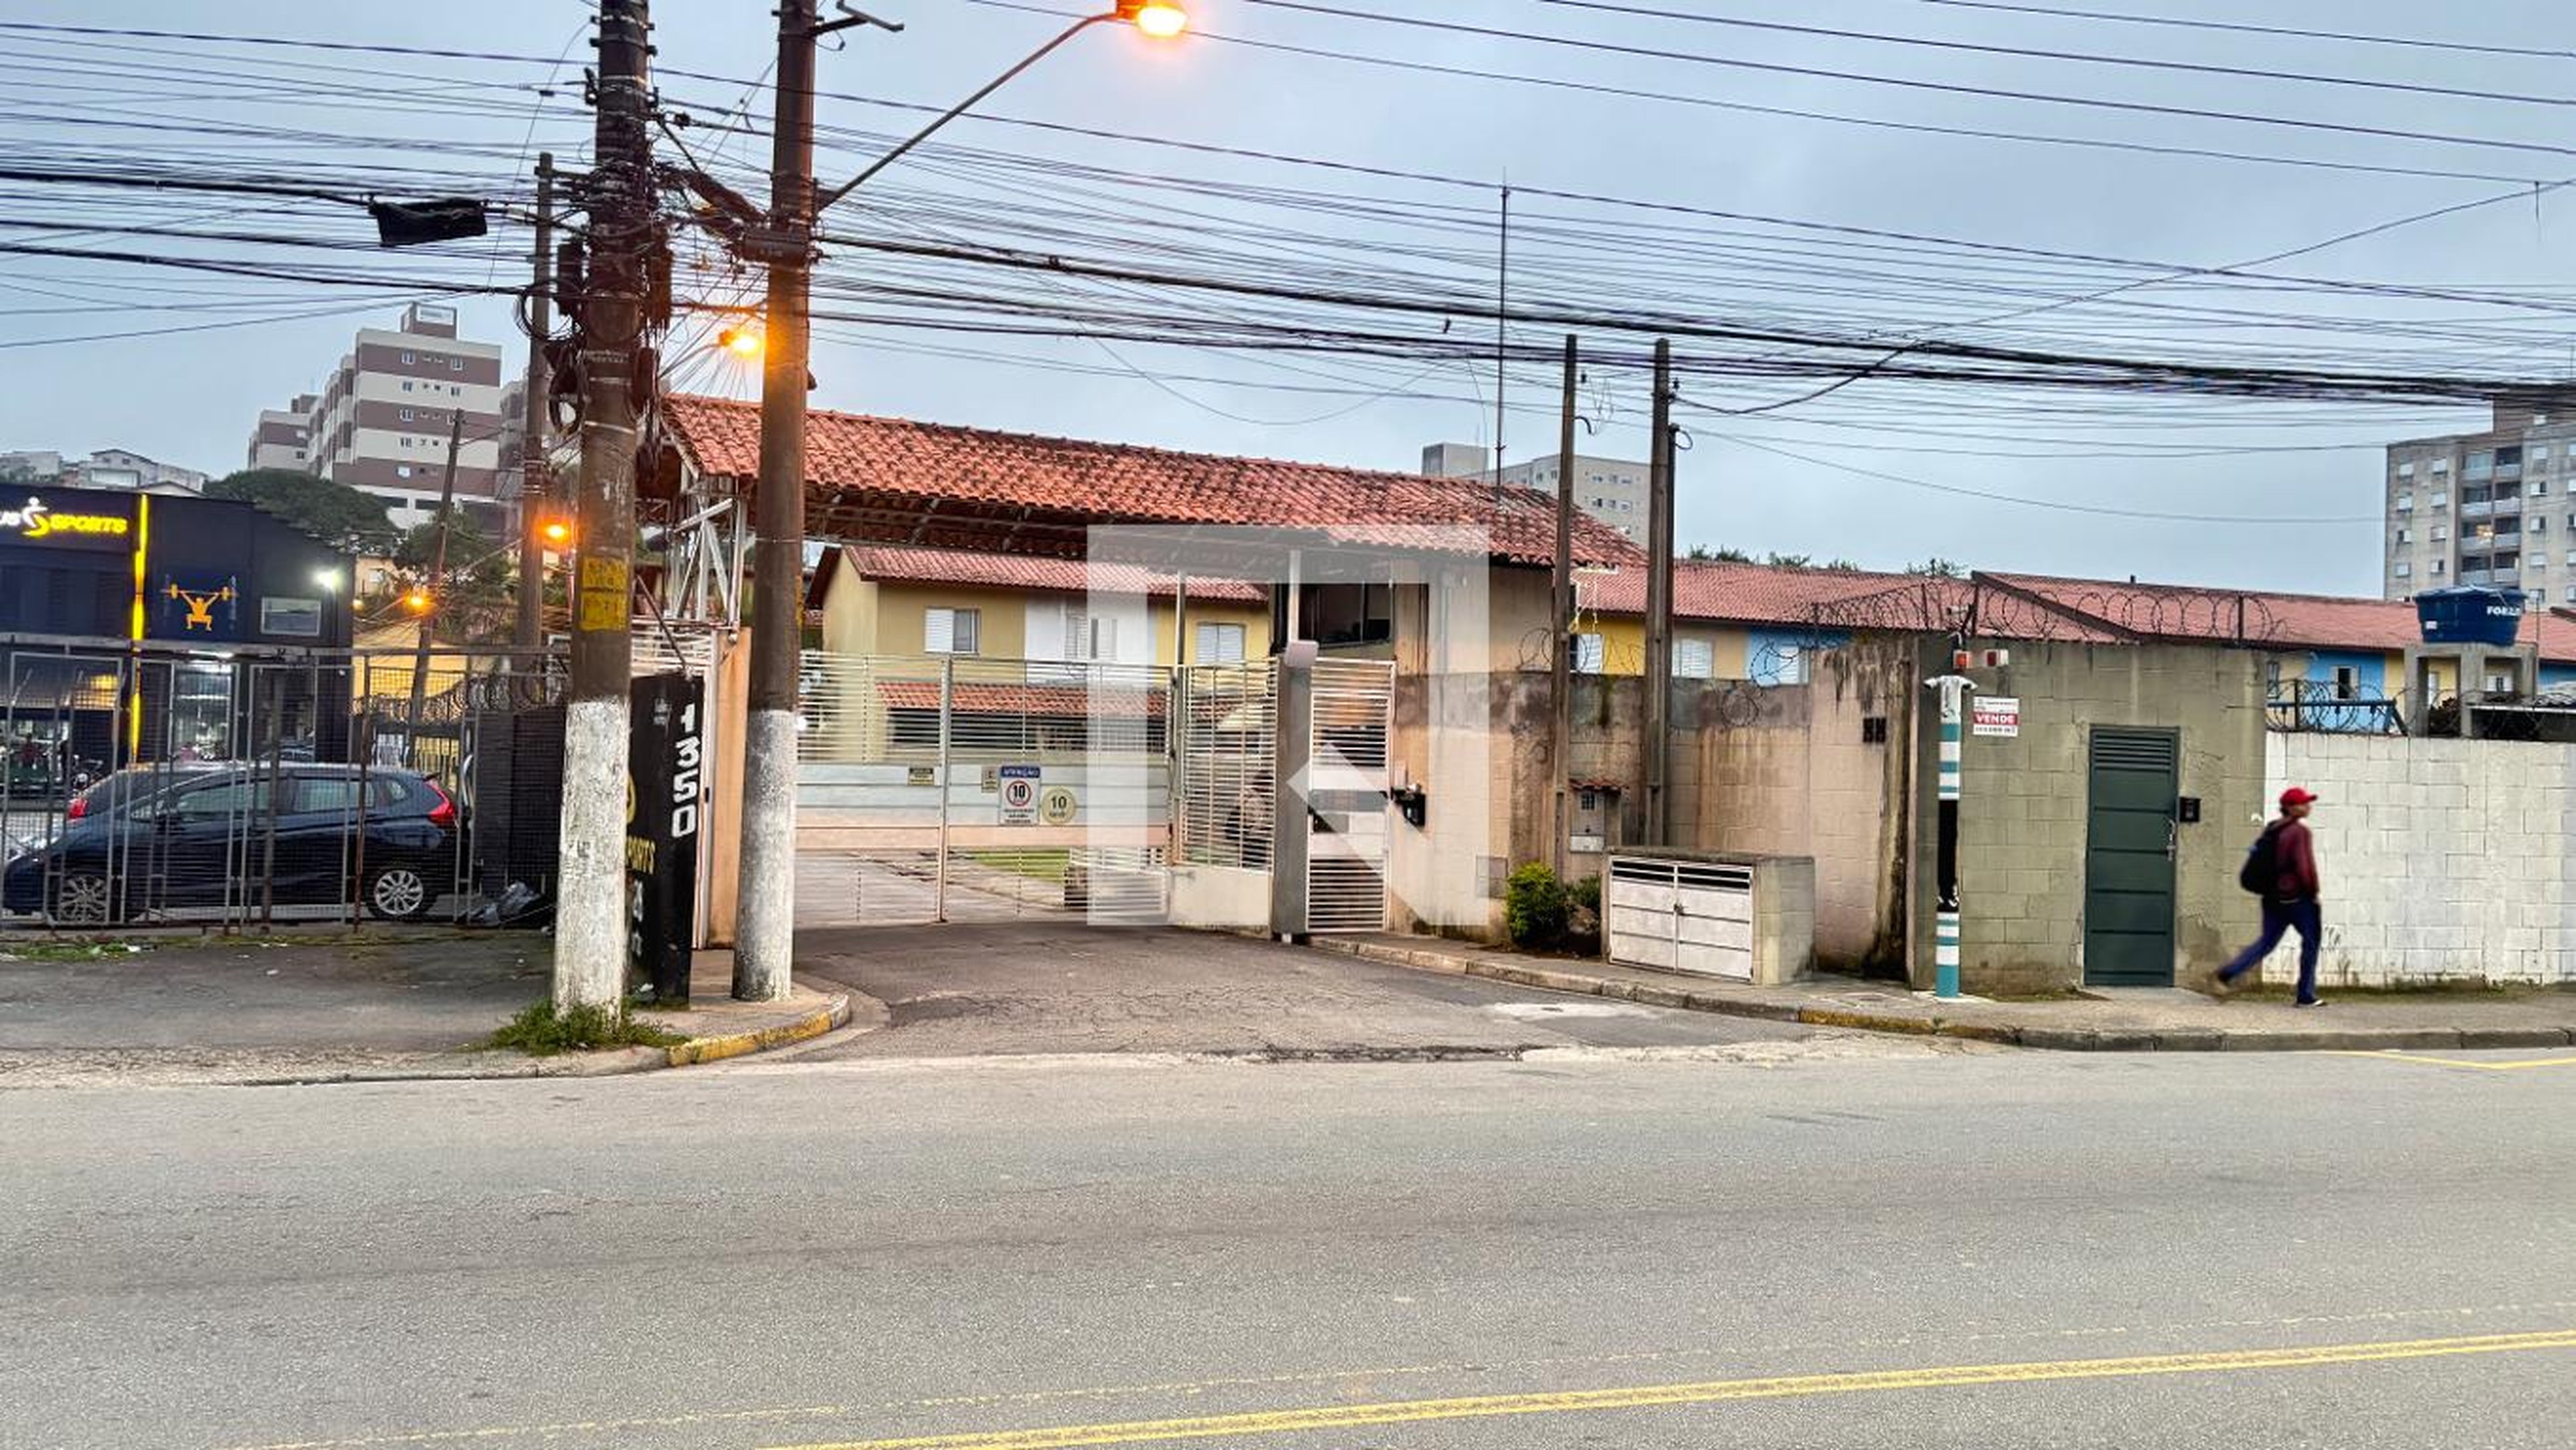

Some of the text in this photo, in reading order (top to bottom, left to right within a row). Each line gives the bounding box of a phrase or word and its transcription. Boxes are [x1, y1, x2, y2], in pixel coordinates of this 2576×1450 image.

[50, 513, 127, 533] SPORTS
[1975, 713, 2016, 724] VENDE
[672, 703, 700, 838] 1350
[1014, 784, 1026, 798] 10
[1051, 796, 1067, 809] 10
